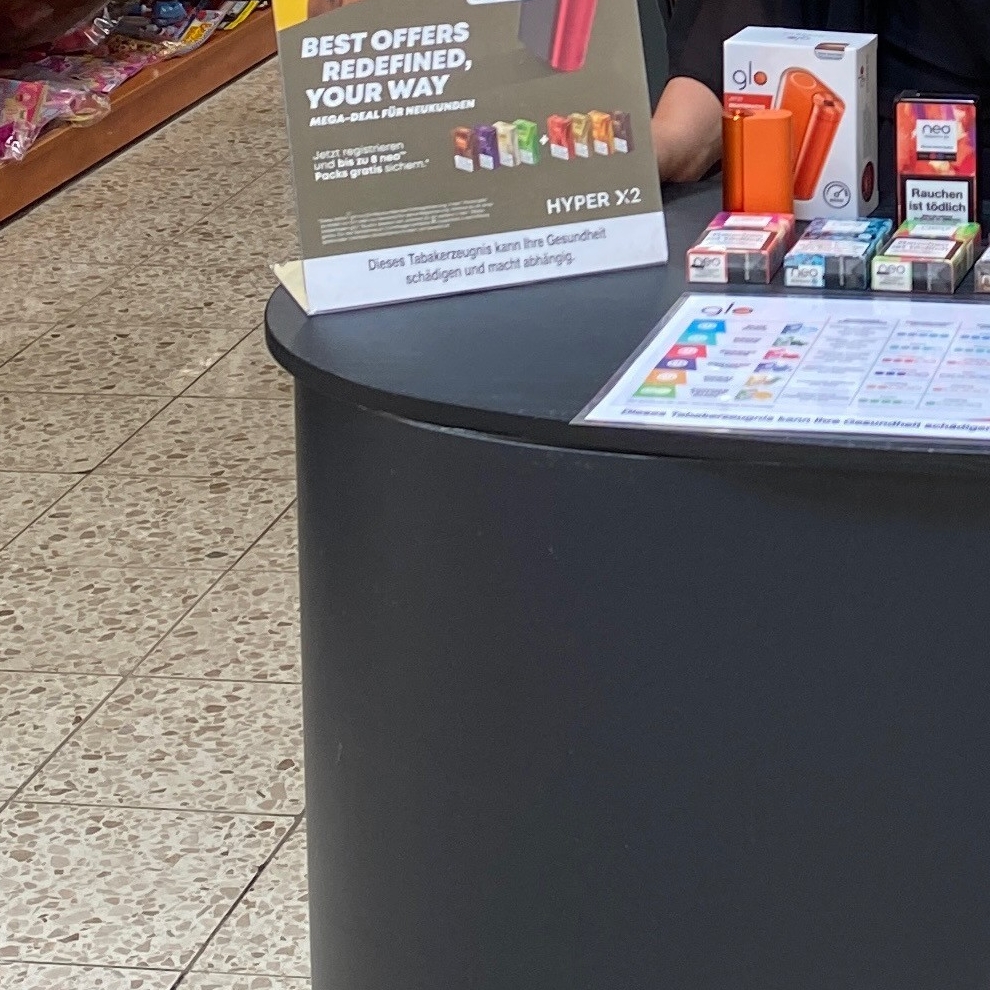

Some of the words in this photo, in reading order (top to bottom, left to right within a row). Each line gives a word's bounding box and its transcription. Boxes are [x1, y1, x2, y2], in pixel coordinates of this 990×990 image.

[301, 31, 366, 58] BEST
[371, 22, 470, 54] OFFERS
[322, 48, 472, 82] REDEFINED,
[732, 60, 768, 90] glo
[305, 84, 382, 109] YOUR
[388, 75, 451, 101] WAY
[309, 112, 382, 127] MEGA-DEAL
[382, 106, 404, 120] FÜR
[405, 98, 475, 117] NEUKUNDEN
[922, 124, 951, 135] neo
[312, 148, 339, 161] Jetzt
[342, 141, 404, 158] registrieren
[314, 159, 335, 170] und
[315, 168, 348, 181] Packs
[350, 163, 383, 179] gratis
[546, 191, 609, 215] HYPER
[615, 187, 642, 205] X2
[909, 202, 922, 211] ist
[926, 202, 966, 212] tödlich
[912, 188, 964, 200] Rauchen
[368, 254, 405, 272] Dieses
[408, 243, 492, 268] Tabakerzeugnis
[495, 240, 520, 254] kann
[522, 235, 545, 249] Ihre
[547, 227, 607, 247] Gesundheit
[405, 266, 462, 286] schädigen
[465, 262, 486, 277] und
[488, 258, 522, 273] macht
[524, 250, 575, 271] abhängig.
[702, 302, 753, 316] glo
